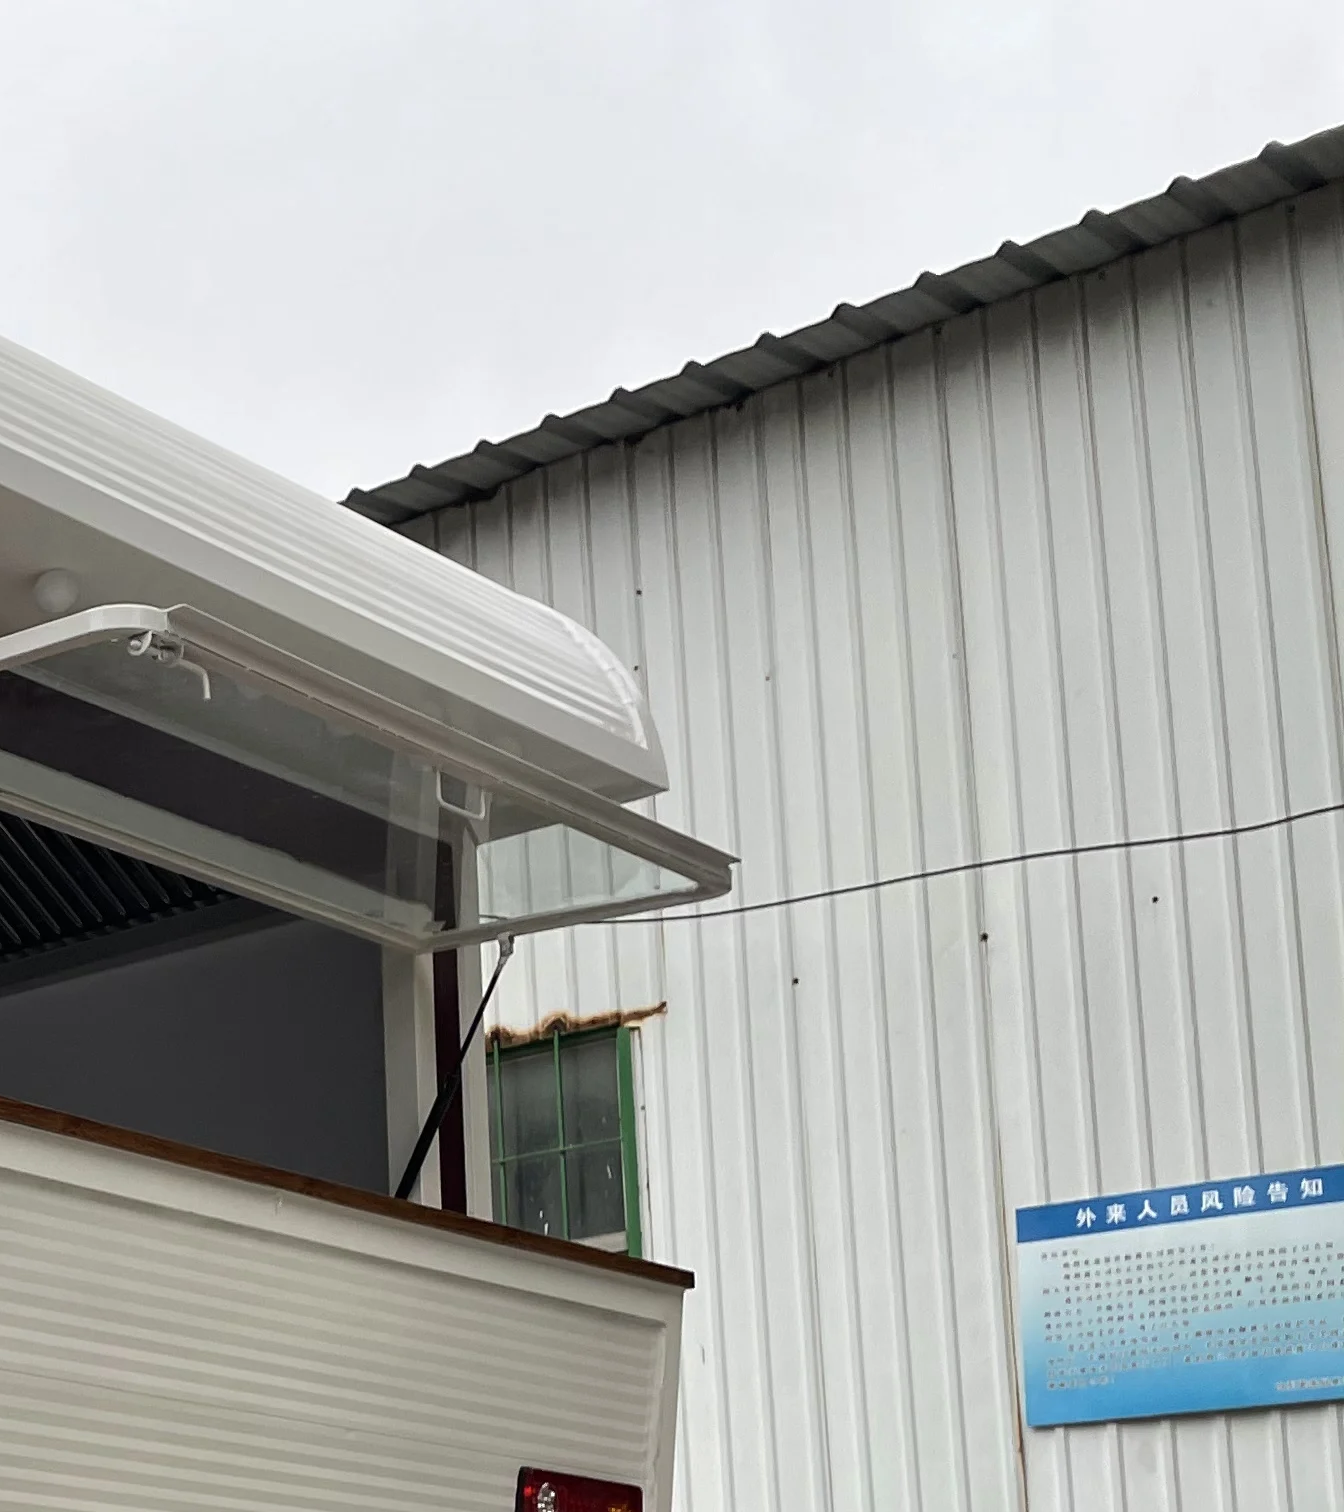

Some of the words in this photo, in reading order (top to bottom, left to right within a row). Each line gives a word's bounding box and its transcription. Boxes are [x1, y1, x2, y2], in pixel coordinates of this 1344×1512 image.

[1075, 1177, 1324, 1230] 外来人员风险告知
